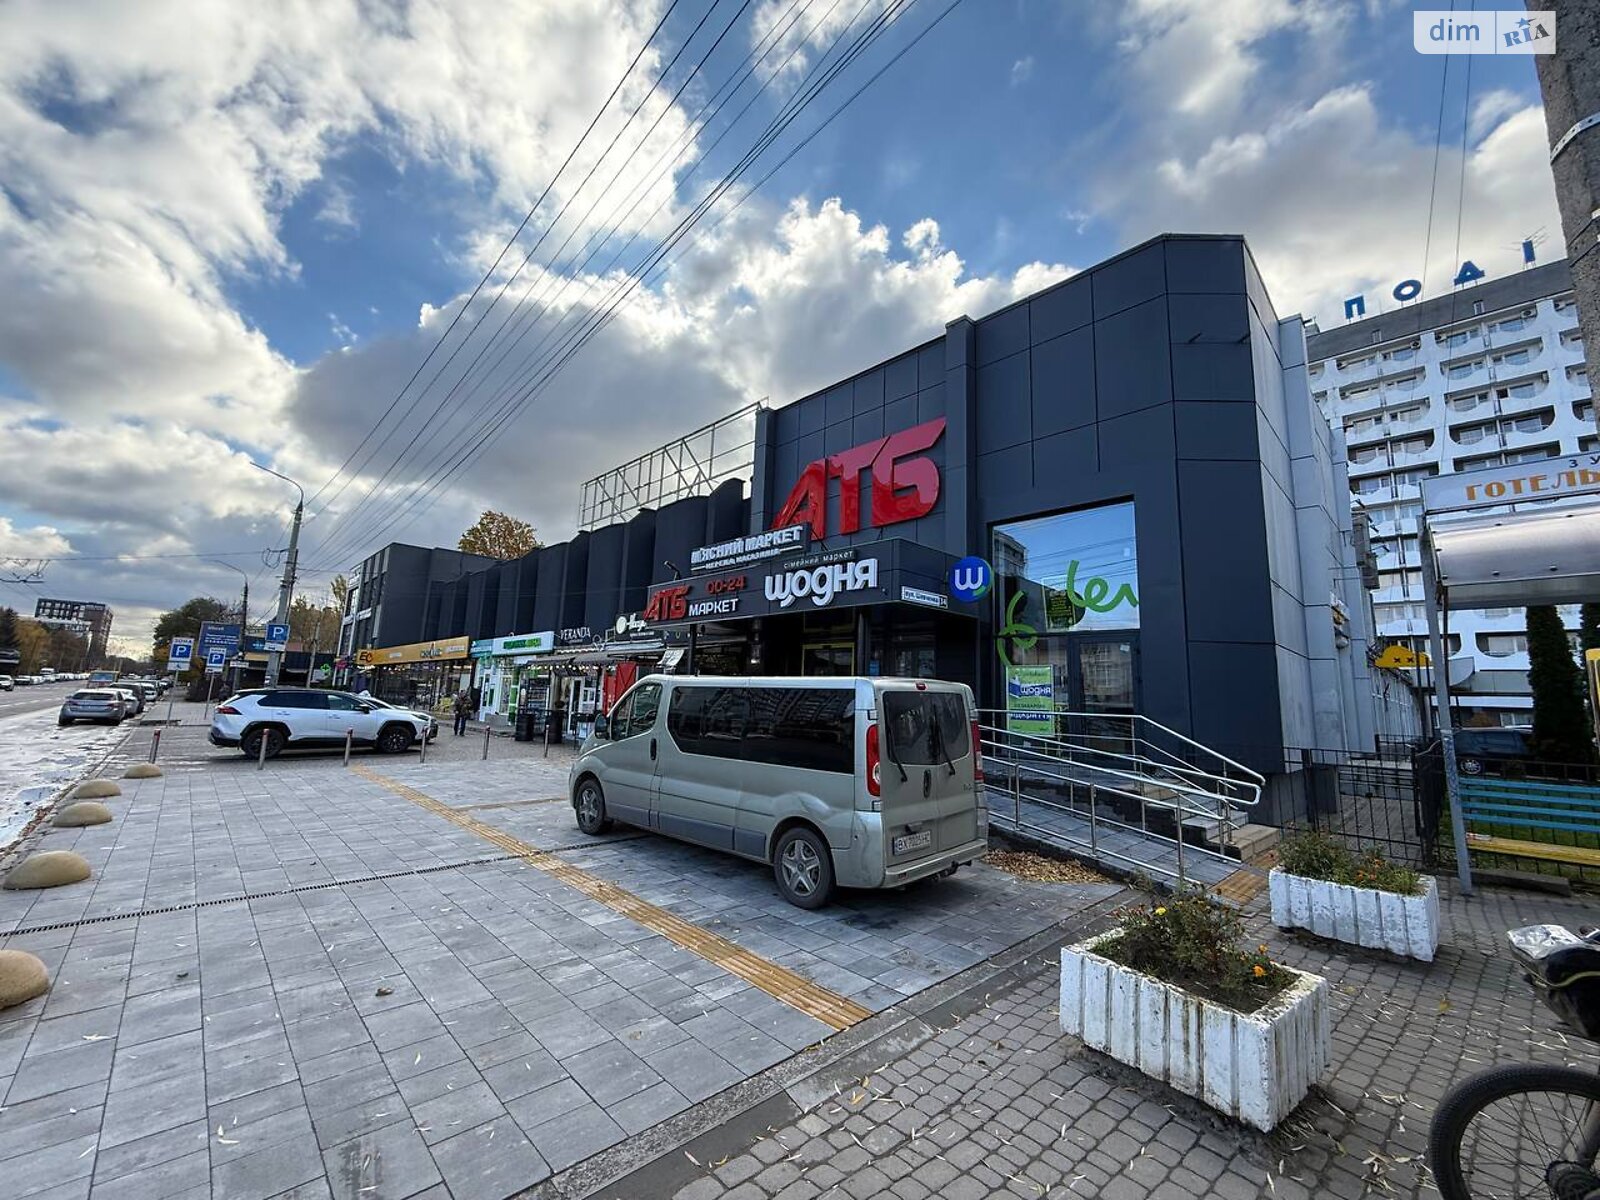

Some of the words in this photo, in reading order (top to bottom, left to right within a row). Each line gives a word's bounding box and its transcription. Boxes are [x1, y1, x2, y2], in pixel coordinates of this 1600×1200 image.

[771, 416, 947, 541] АТБ
[745, 525, 803, 552] МАРКЕТ
[643, 584, 690, 621] АТБ
[688, 598, 739, 617] МАРКЕТ
